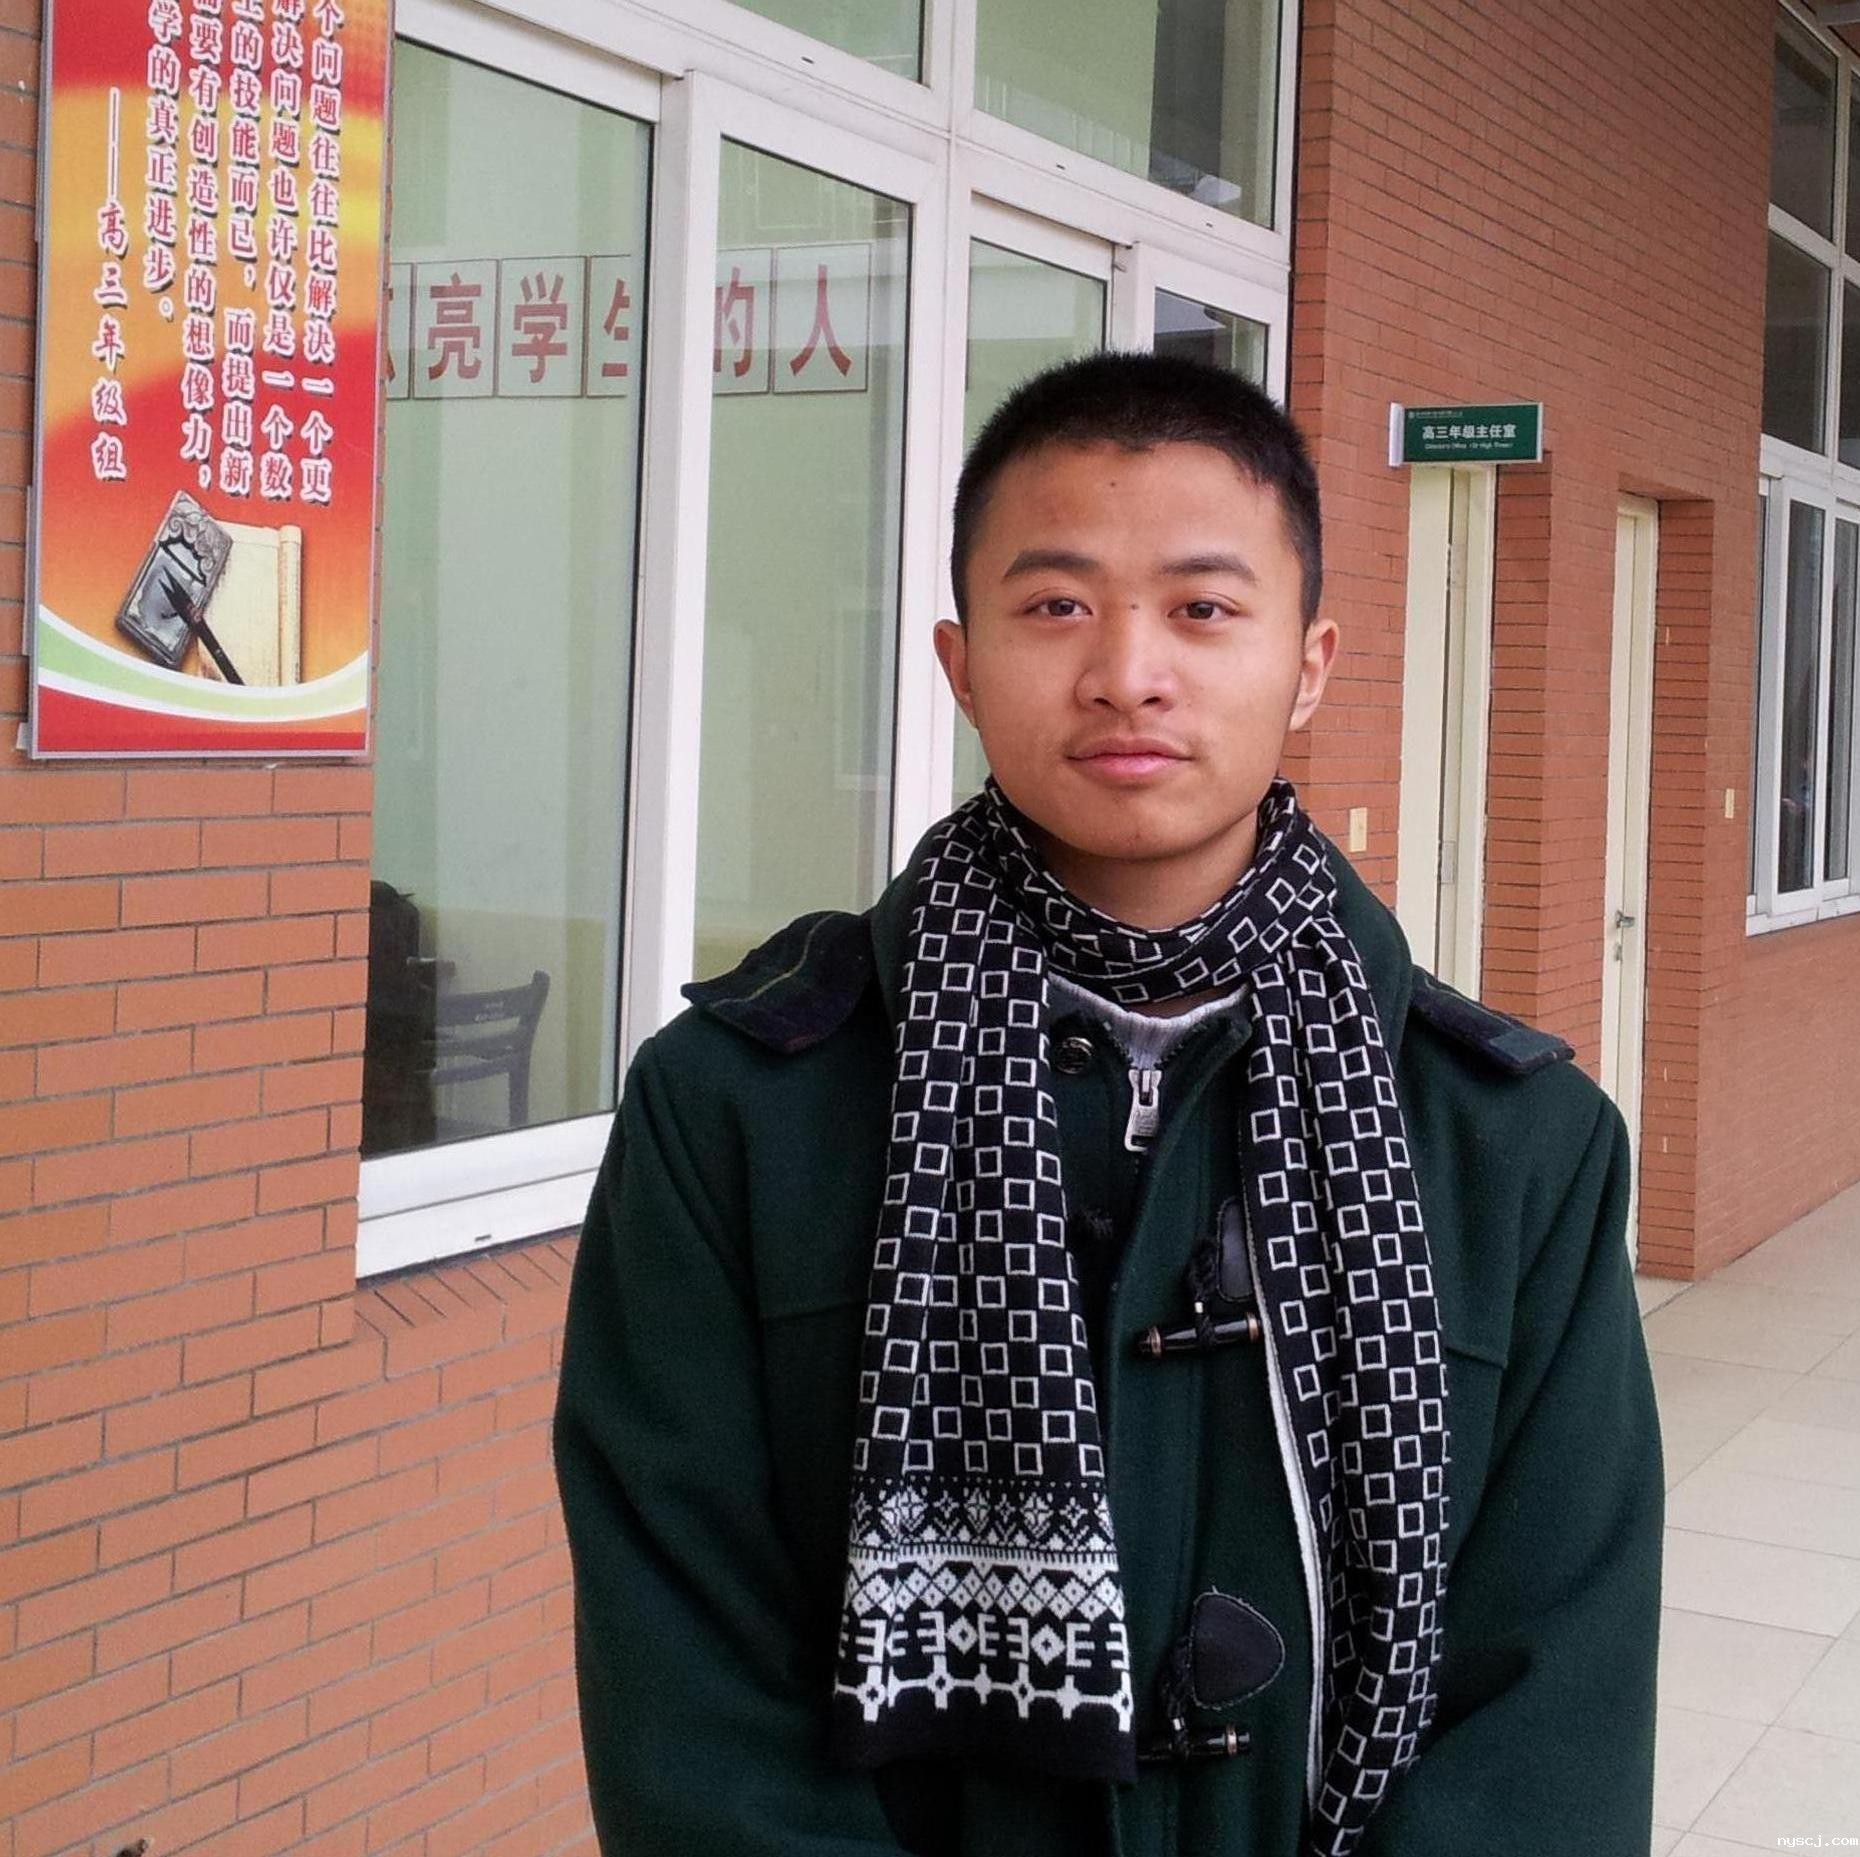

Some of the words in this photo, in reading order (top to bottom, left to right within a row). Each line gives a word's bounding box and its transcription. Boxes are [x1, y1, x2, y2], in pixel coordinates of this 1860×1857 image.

[1422, 424, 1517, 440] 高三年级主任室
